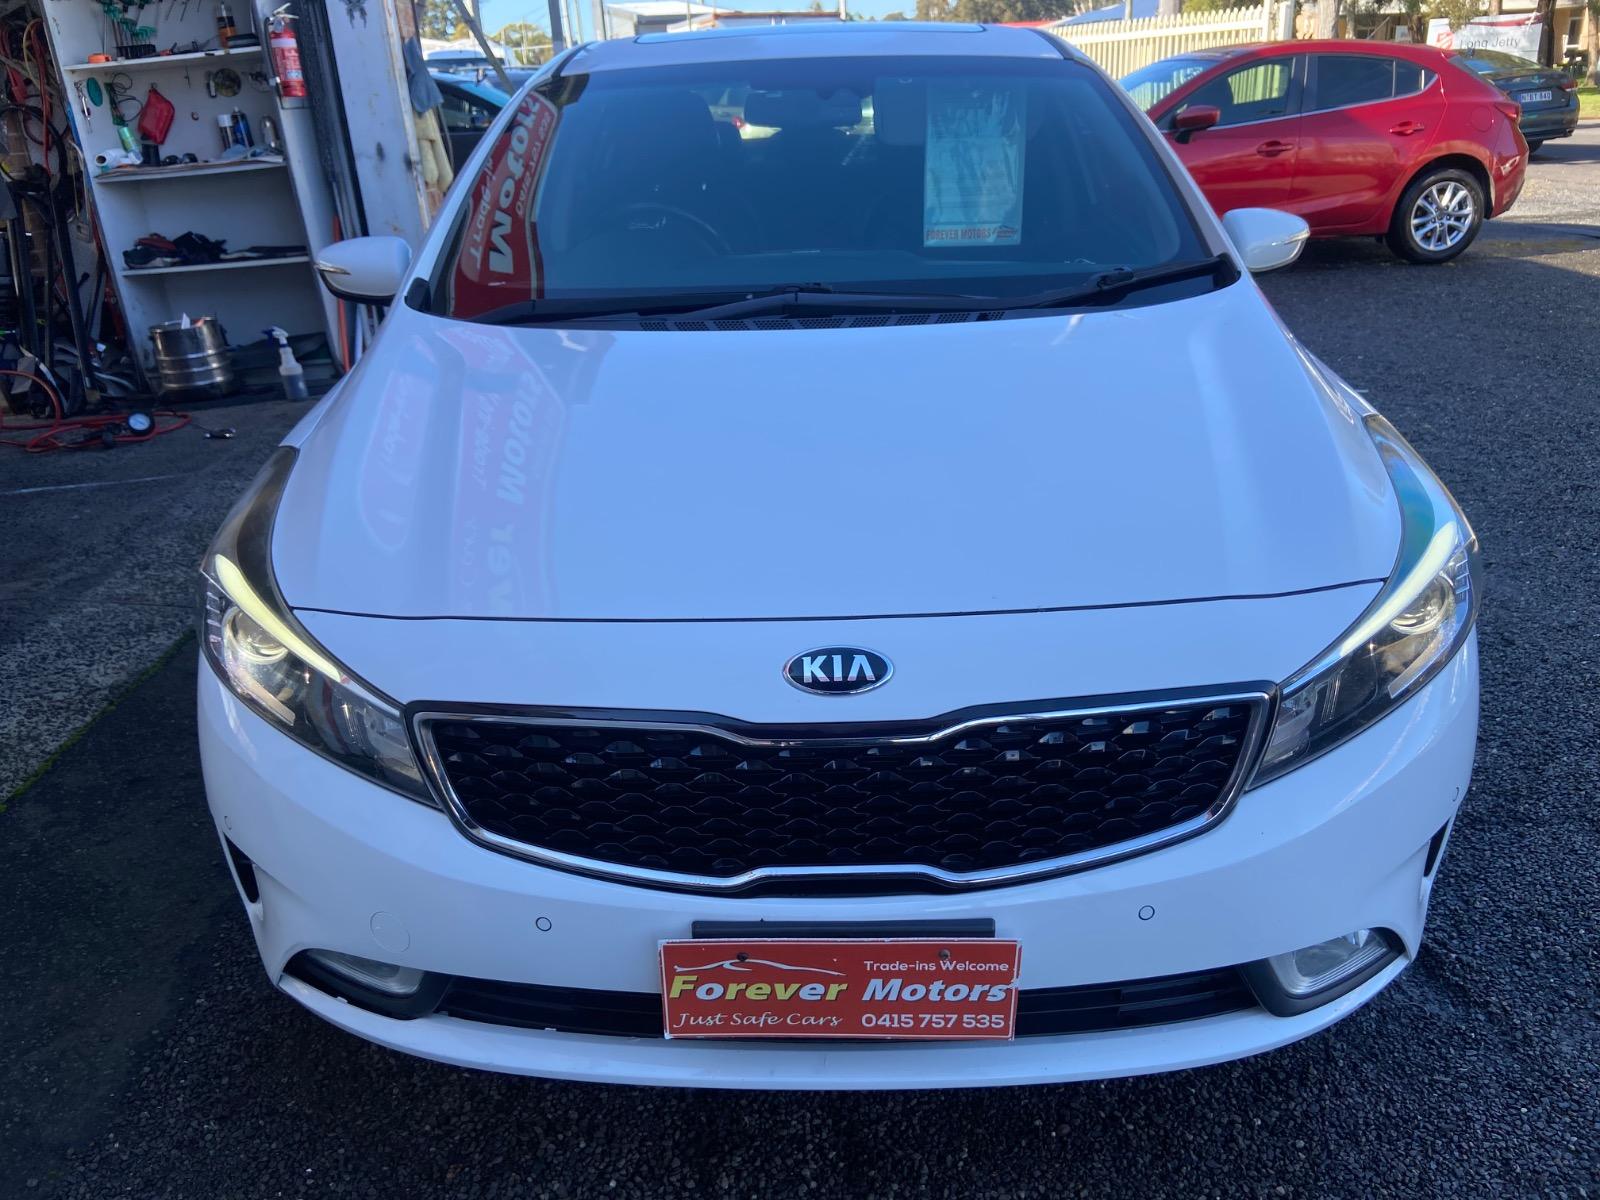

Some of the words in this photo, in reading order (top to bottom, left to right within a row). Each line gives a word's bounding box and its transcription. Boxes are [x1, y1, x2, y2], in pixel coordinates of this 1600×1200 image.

[1491, 36, 1521, 49] Jetty
[801, 654, 876, 683] KIA
[864, 960, 937, 971] Trade-ins
[940, 960, 1009, 971] Welcome
[669, 975, 849, 1001] Forever
[861, 978, 1010, 1002] Motors
[673, 1012, 728, 1028] Just
[730, 1011, 783, 1028] Safe
[786, 1012, 843, 1028] Cars
[861, 1013, 914, 1028] 0415
[918, 1013, 958, 1028] 757
[962, 1013, 1005, 1028] 535
